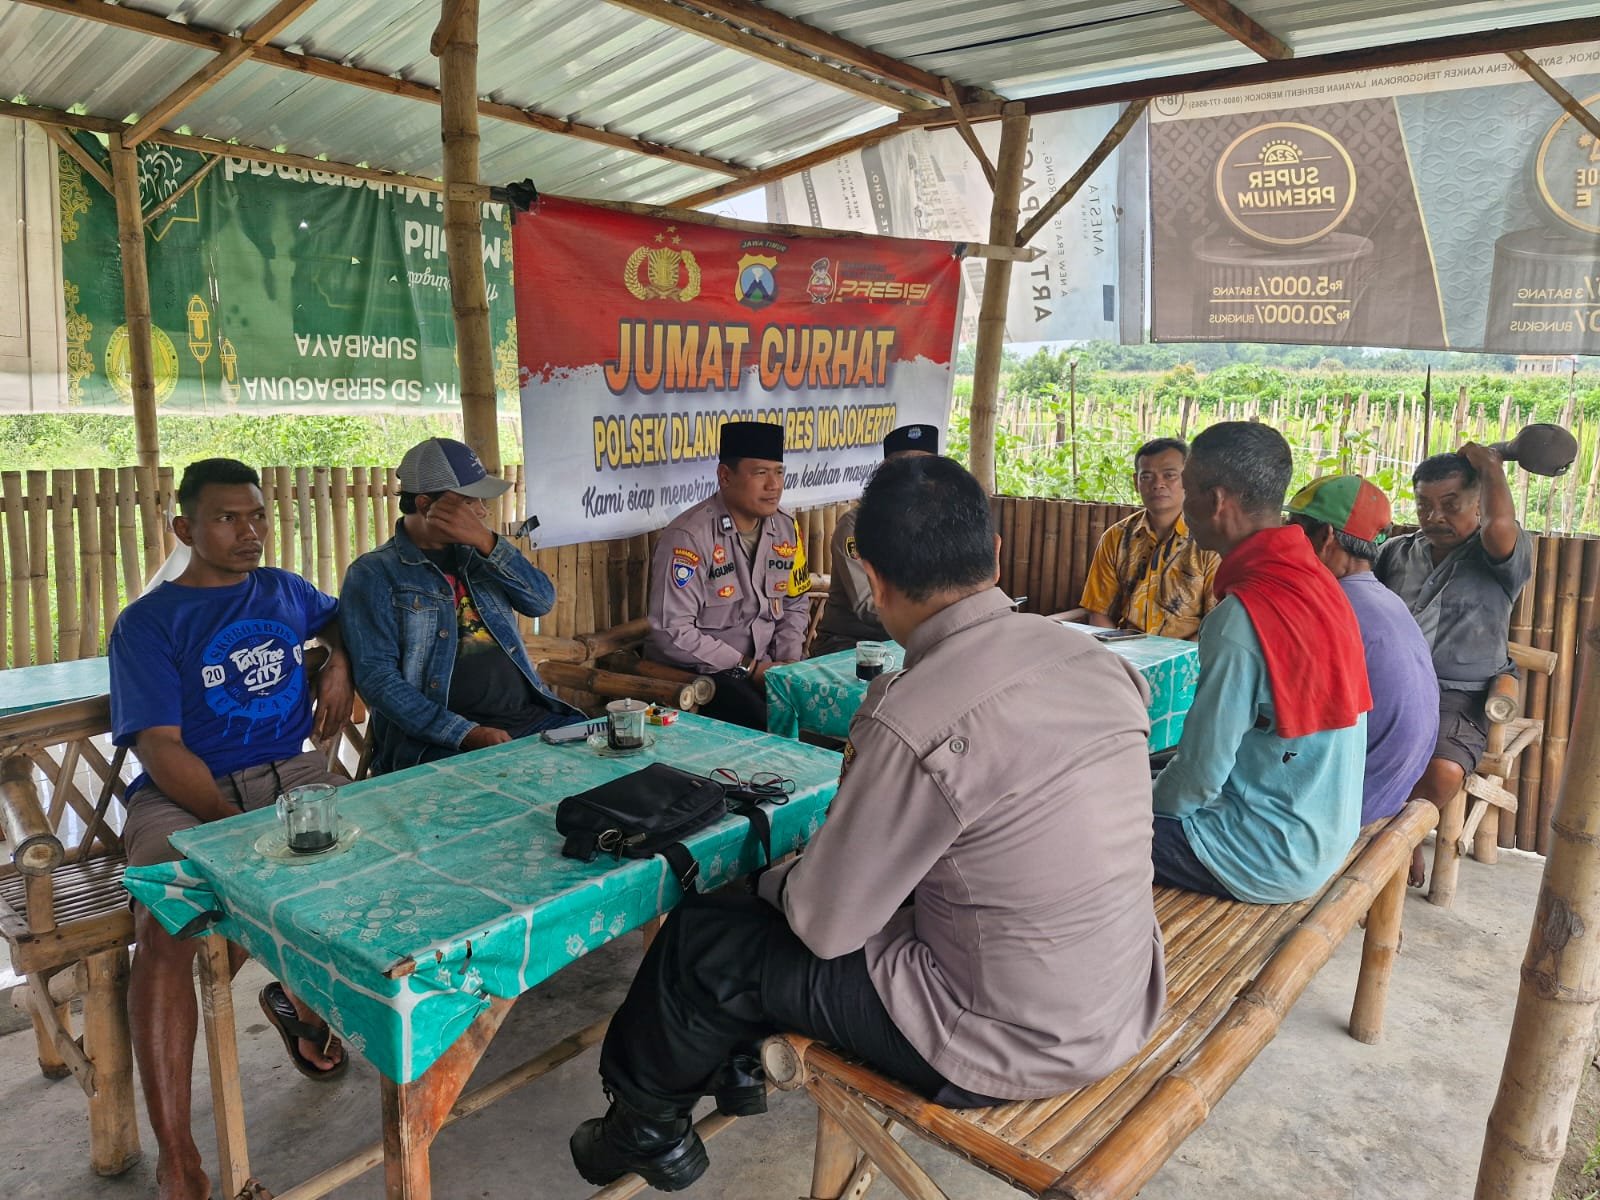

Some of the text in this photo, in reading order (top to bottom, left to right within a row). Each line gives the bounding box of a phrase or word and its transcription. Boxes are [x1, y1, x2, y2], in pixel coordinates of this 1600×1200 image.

[838, 280, 932, 300] PRESISI
[294, 333, 418, 361] SURABAYA
[605, 320, 896, 394] JUMAT CURHAT
[242, 376, 387, 402] SERBAGUNA
[392, 378, 422, 402] SD
[593, 414, 668, 470] POLSEK
[817, 403, 897, 451] MOJOKERTO
[582, 484, 625, 519] Kami
[627, 482, 655, 516] siap
[660, 476, 720, 507] menerim
[800, 462, 841, 488] keluhan
[206, 668, 222, 684] 20
